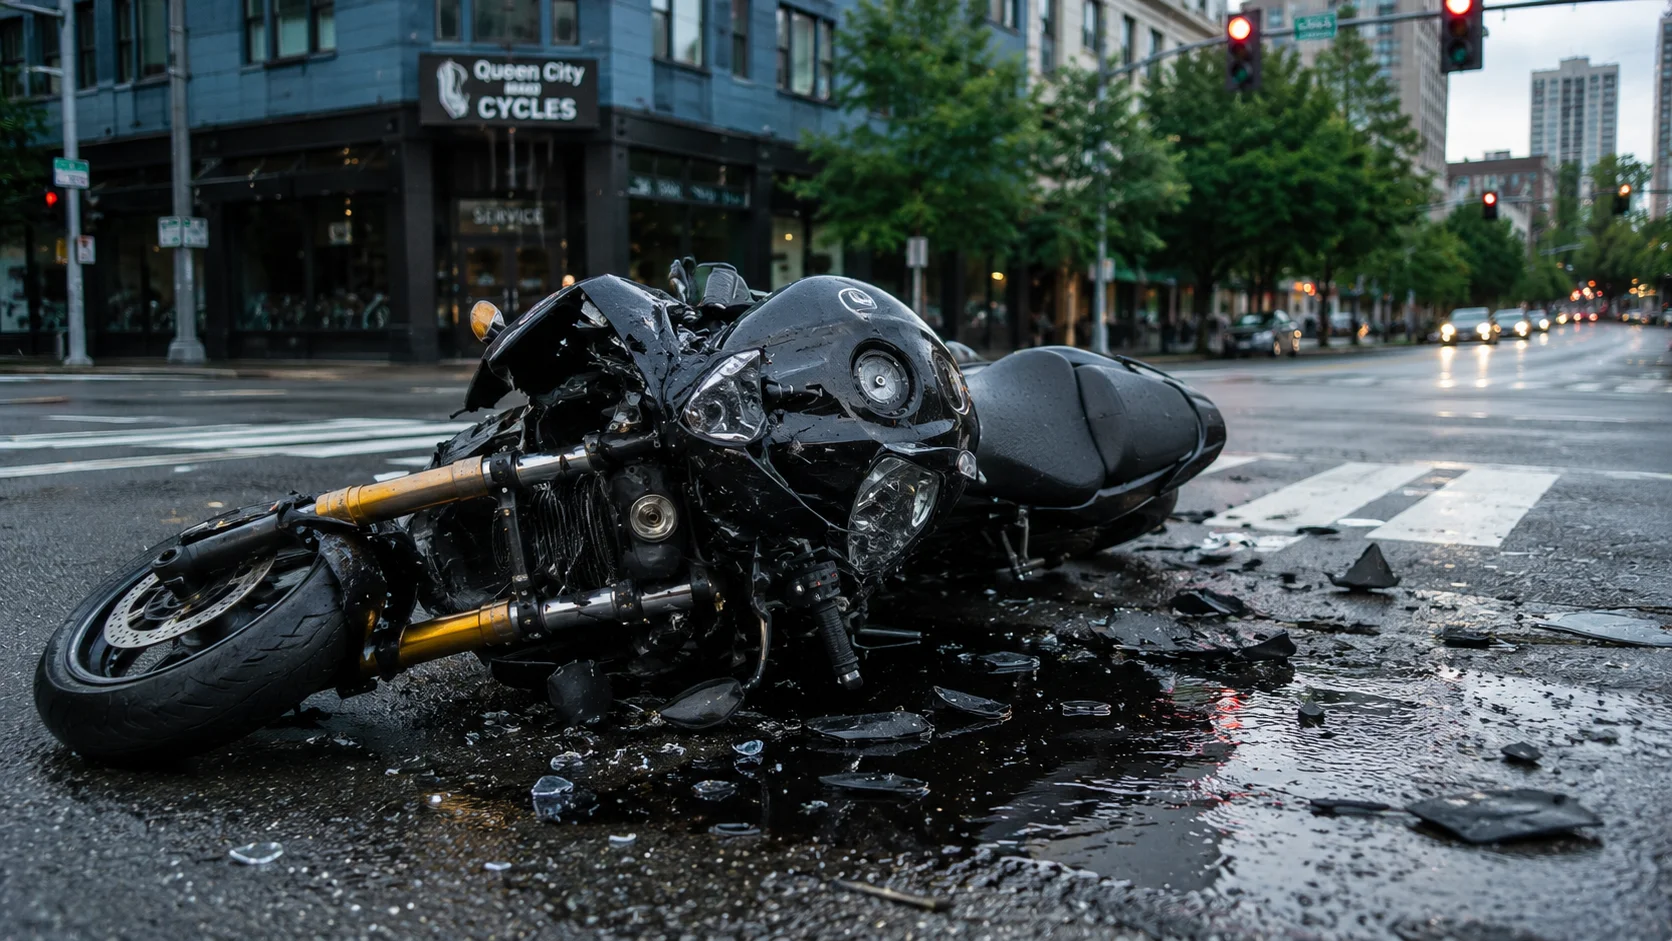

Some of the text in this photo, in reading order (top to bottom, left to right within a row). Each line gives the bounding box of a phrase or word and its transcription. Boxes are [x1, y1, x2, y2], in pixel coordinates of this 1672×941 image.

[474, 60, 585, 86] Queen City
[478, 96, 577, 120] CYCLES
[474, 208, 543, 225] SERVICE
